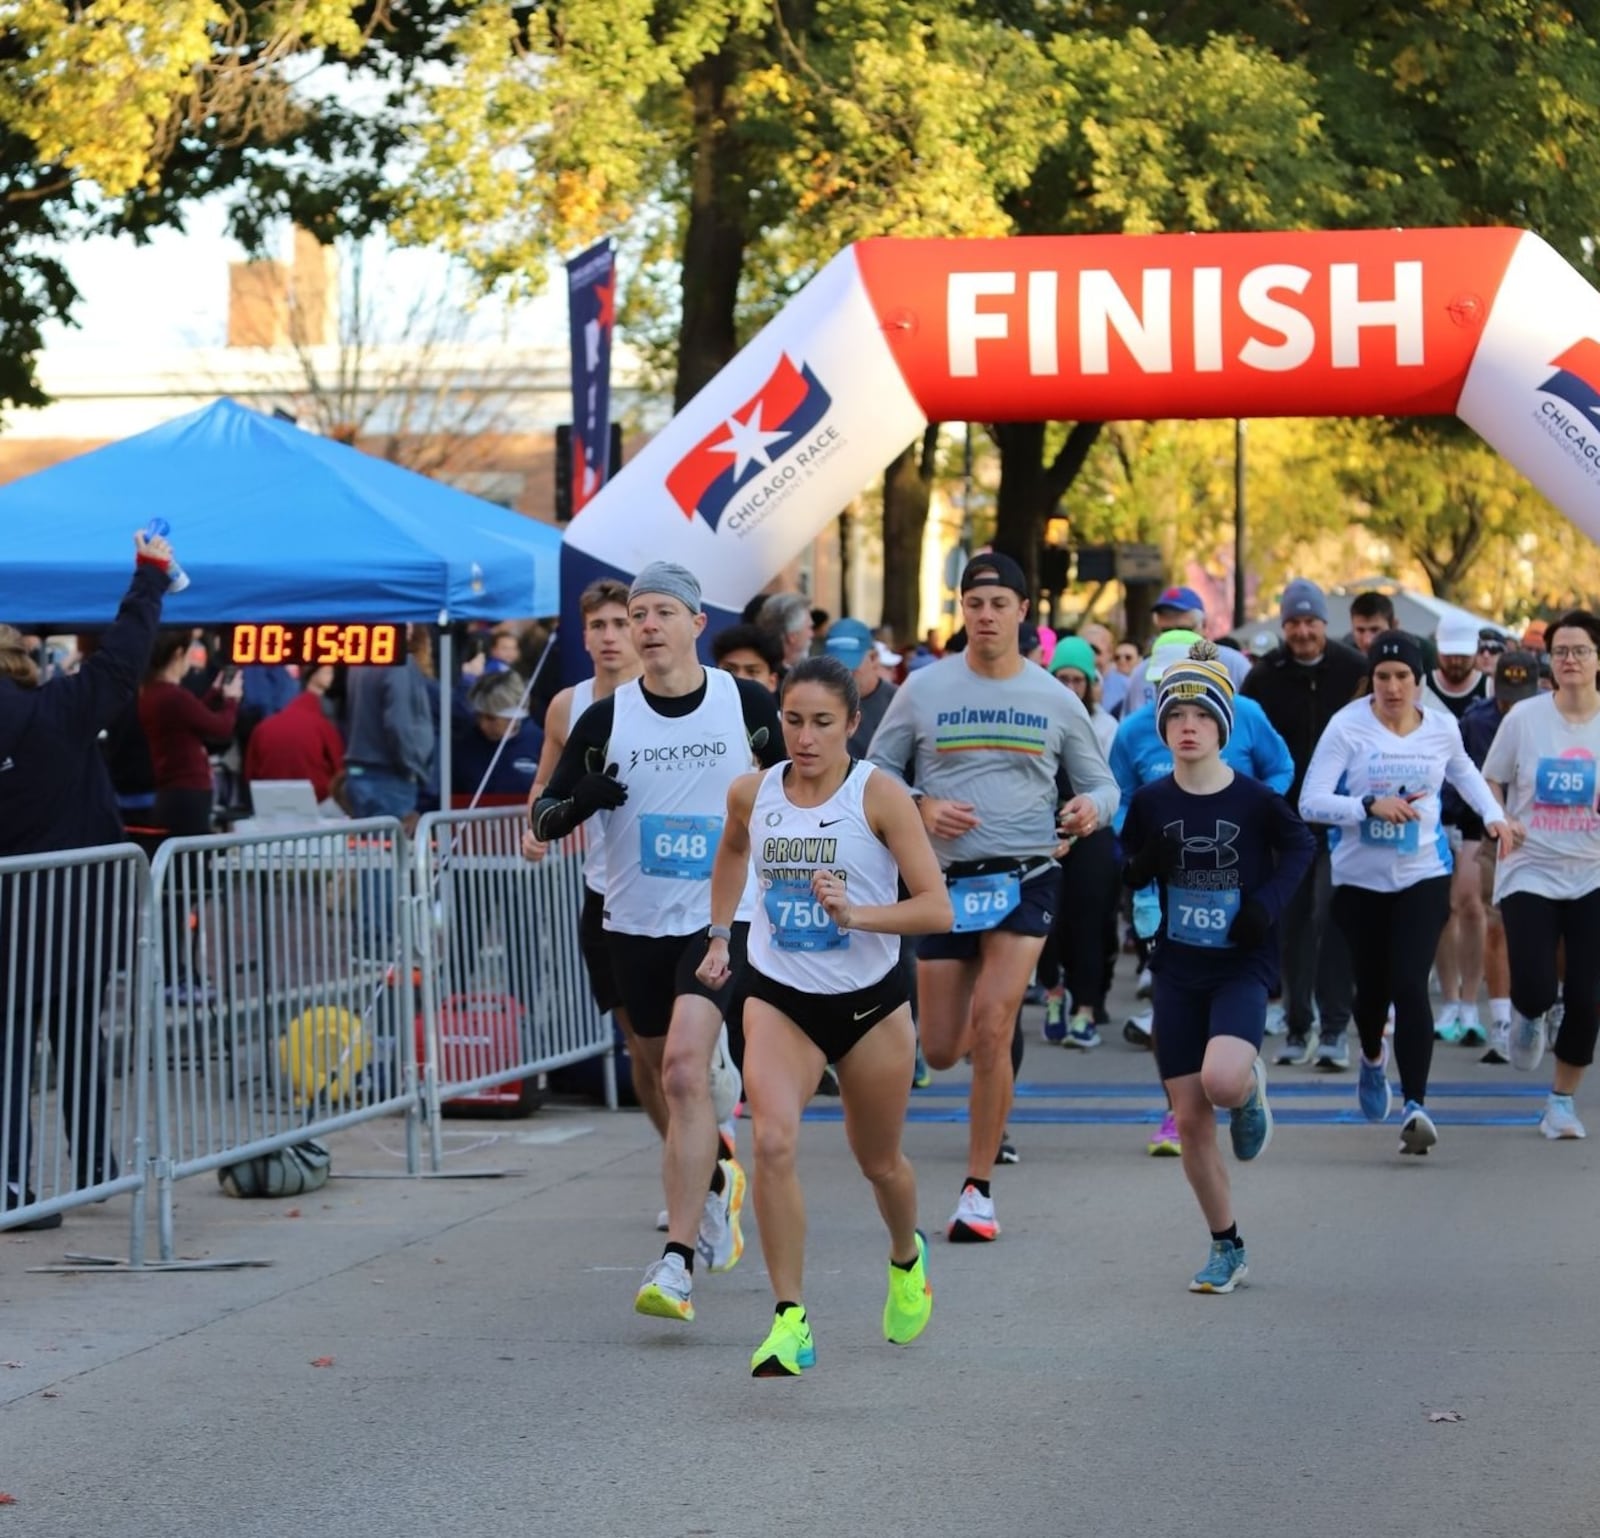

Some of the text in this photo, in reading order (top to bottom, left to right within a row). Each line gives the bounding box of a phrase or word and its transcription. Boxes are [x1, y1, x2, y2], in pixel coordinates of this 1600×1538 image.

[947, 261, 1424, 377] FINISH
[727, 425, 840, 529] CHICAGO RACE
[232, 625, 396, 663] 00:15:08
[644, 741, 727, 762] DICK POND
[655, 759, 717, 772] RACING
[1546, 772, 1584, 791] 735
[1370, 820, 1405, 839] 681
[655, 833, 707, 859] 648
[763, 837, 838, 863] CROWN
[776, 901, 830, 928] 750
[964, 890, 1008, 914] 678
[1179, 905, 1227, 930] 763
